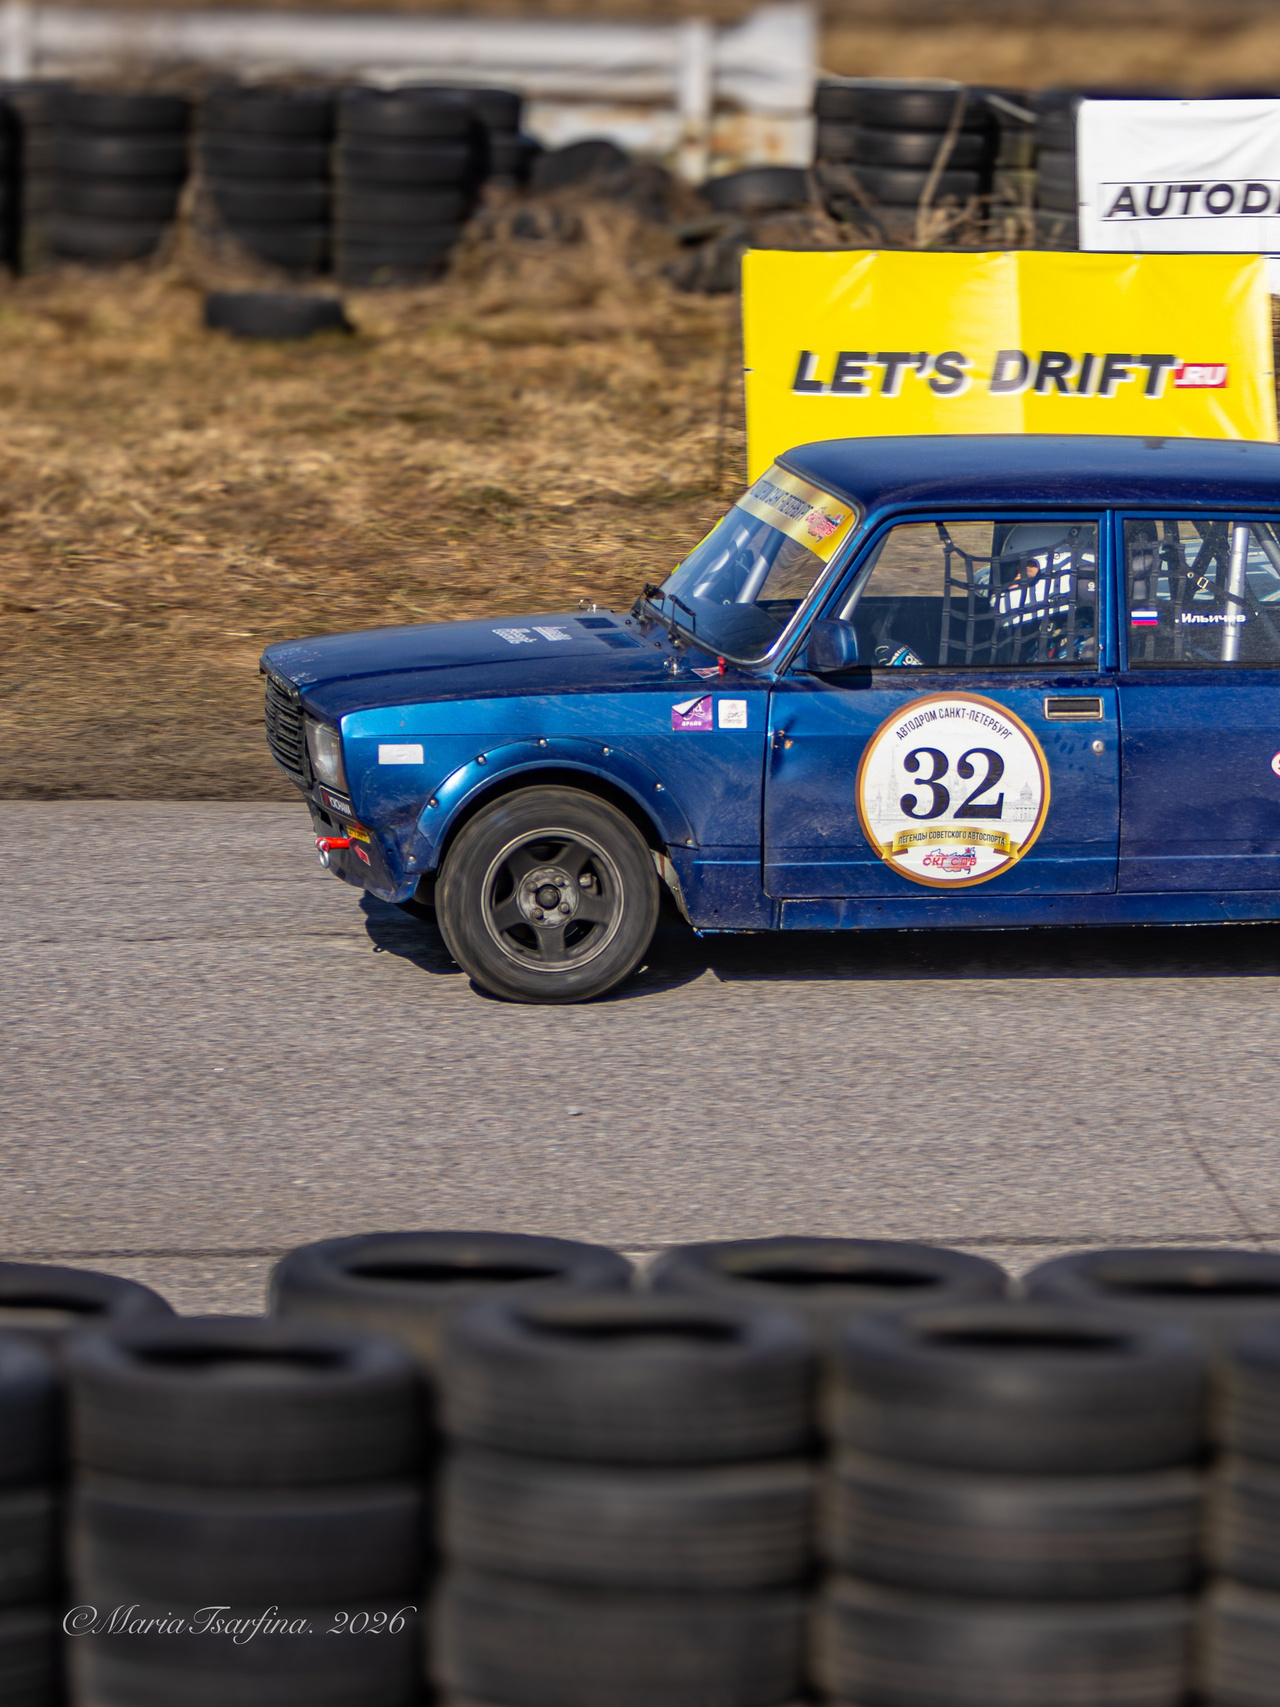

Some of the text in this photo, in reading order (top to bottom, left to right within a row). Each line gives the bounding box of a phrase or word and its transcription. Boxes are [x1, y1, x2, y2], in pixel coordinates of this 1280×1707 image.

[793, 350, 970, 397] LET'S
[896, 707, 1013, 741] АВТОДРОМ САНКТ-ПЕТЕРБУРГ
[900, 747, 1005, 820] 32
[898, 830, 1006, 846] ЛЕГЕНДЫ СОВЕТСКОГО АВТОСПОРТА
[951, 857, 976, 866] СПБ
